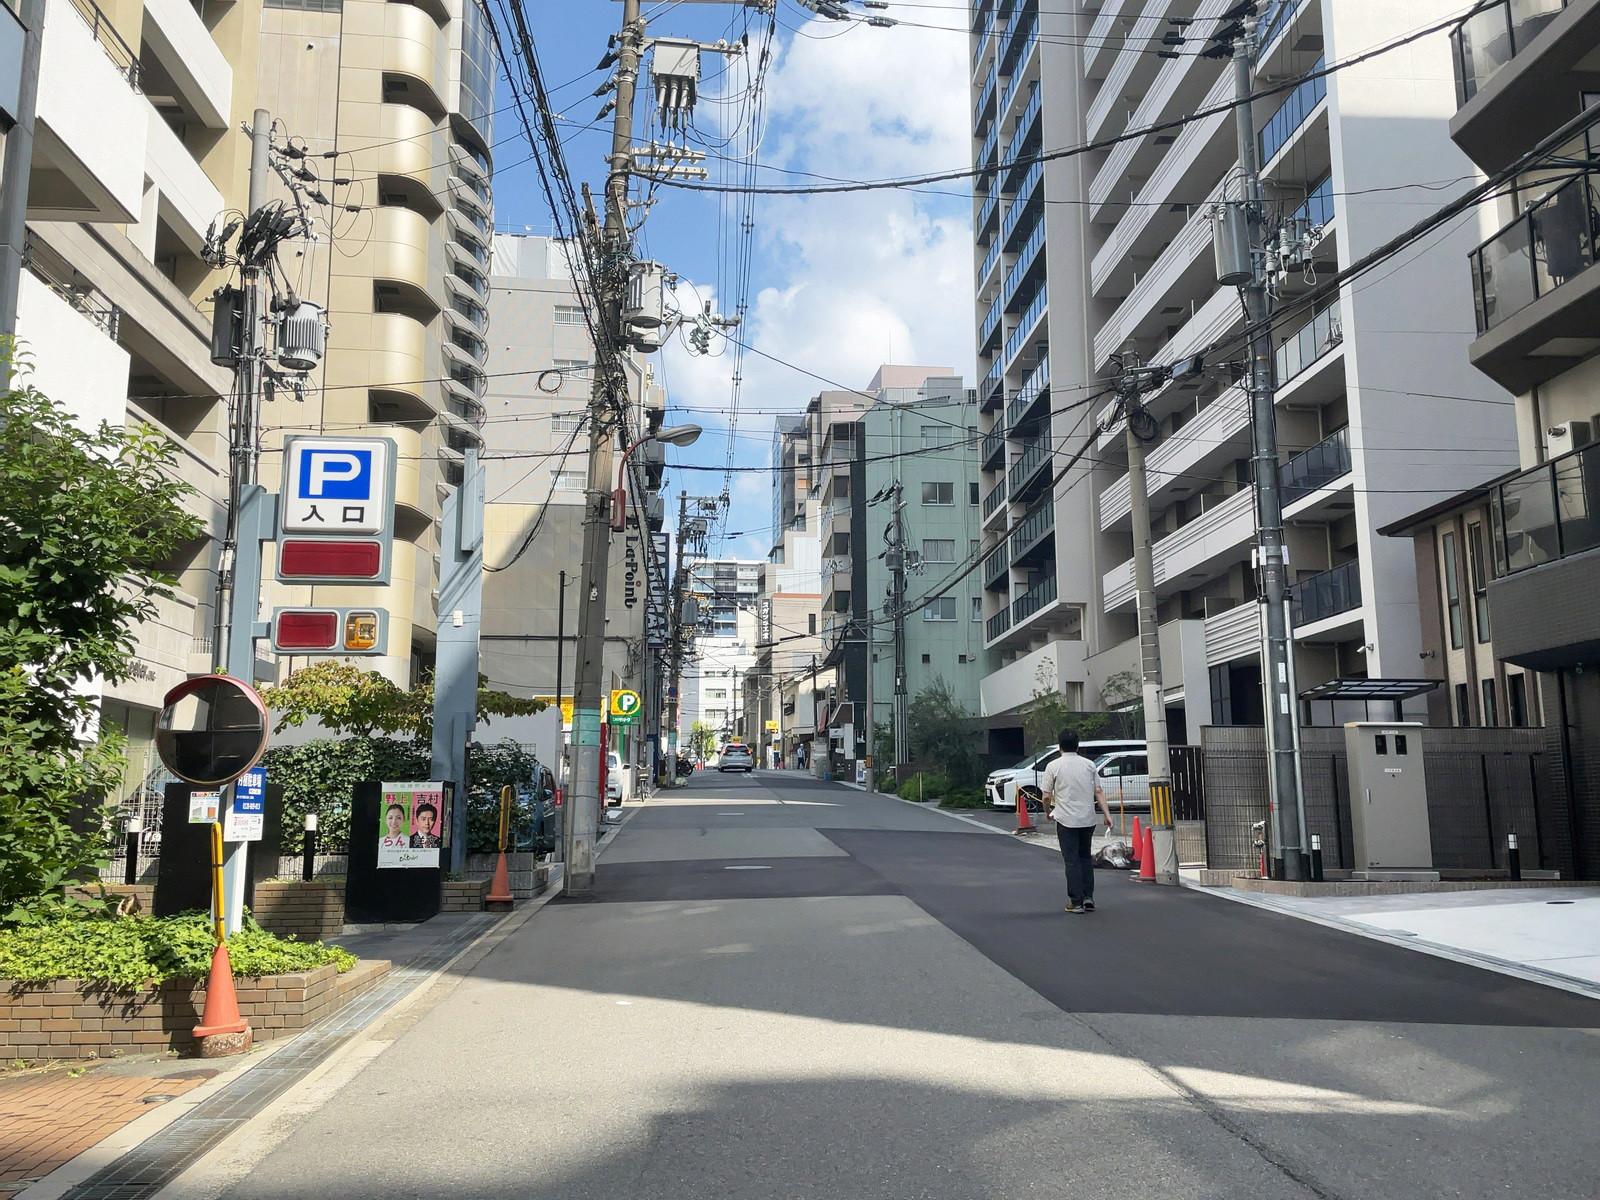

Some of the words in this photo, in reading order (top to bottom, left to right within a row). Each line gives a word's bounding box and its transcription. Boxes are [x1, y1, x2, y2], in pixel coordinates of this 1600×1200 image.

[309, 453, 361, 495] P
[302, 505, 365, 523] 入口
[622, 694, 635, 711] P
[385, 793, 408, 805] 野上
[416, 793, 439, 804] 吉村
[384, 836, 405, 847] らん
